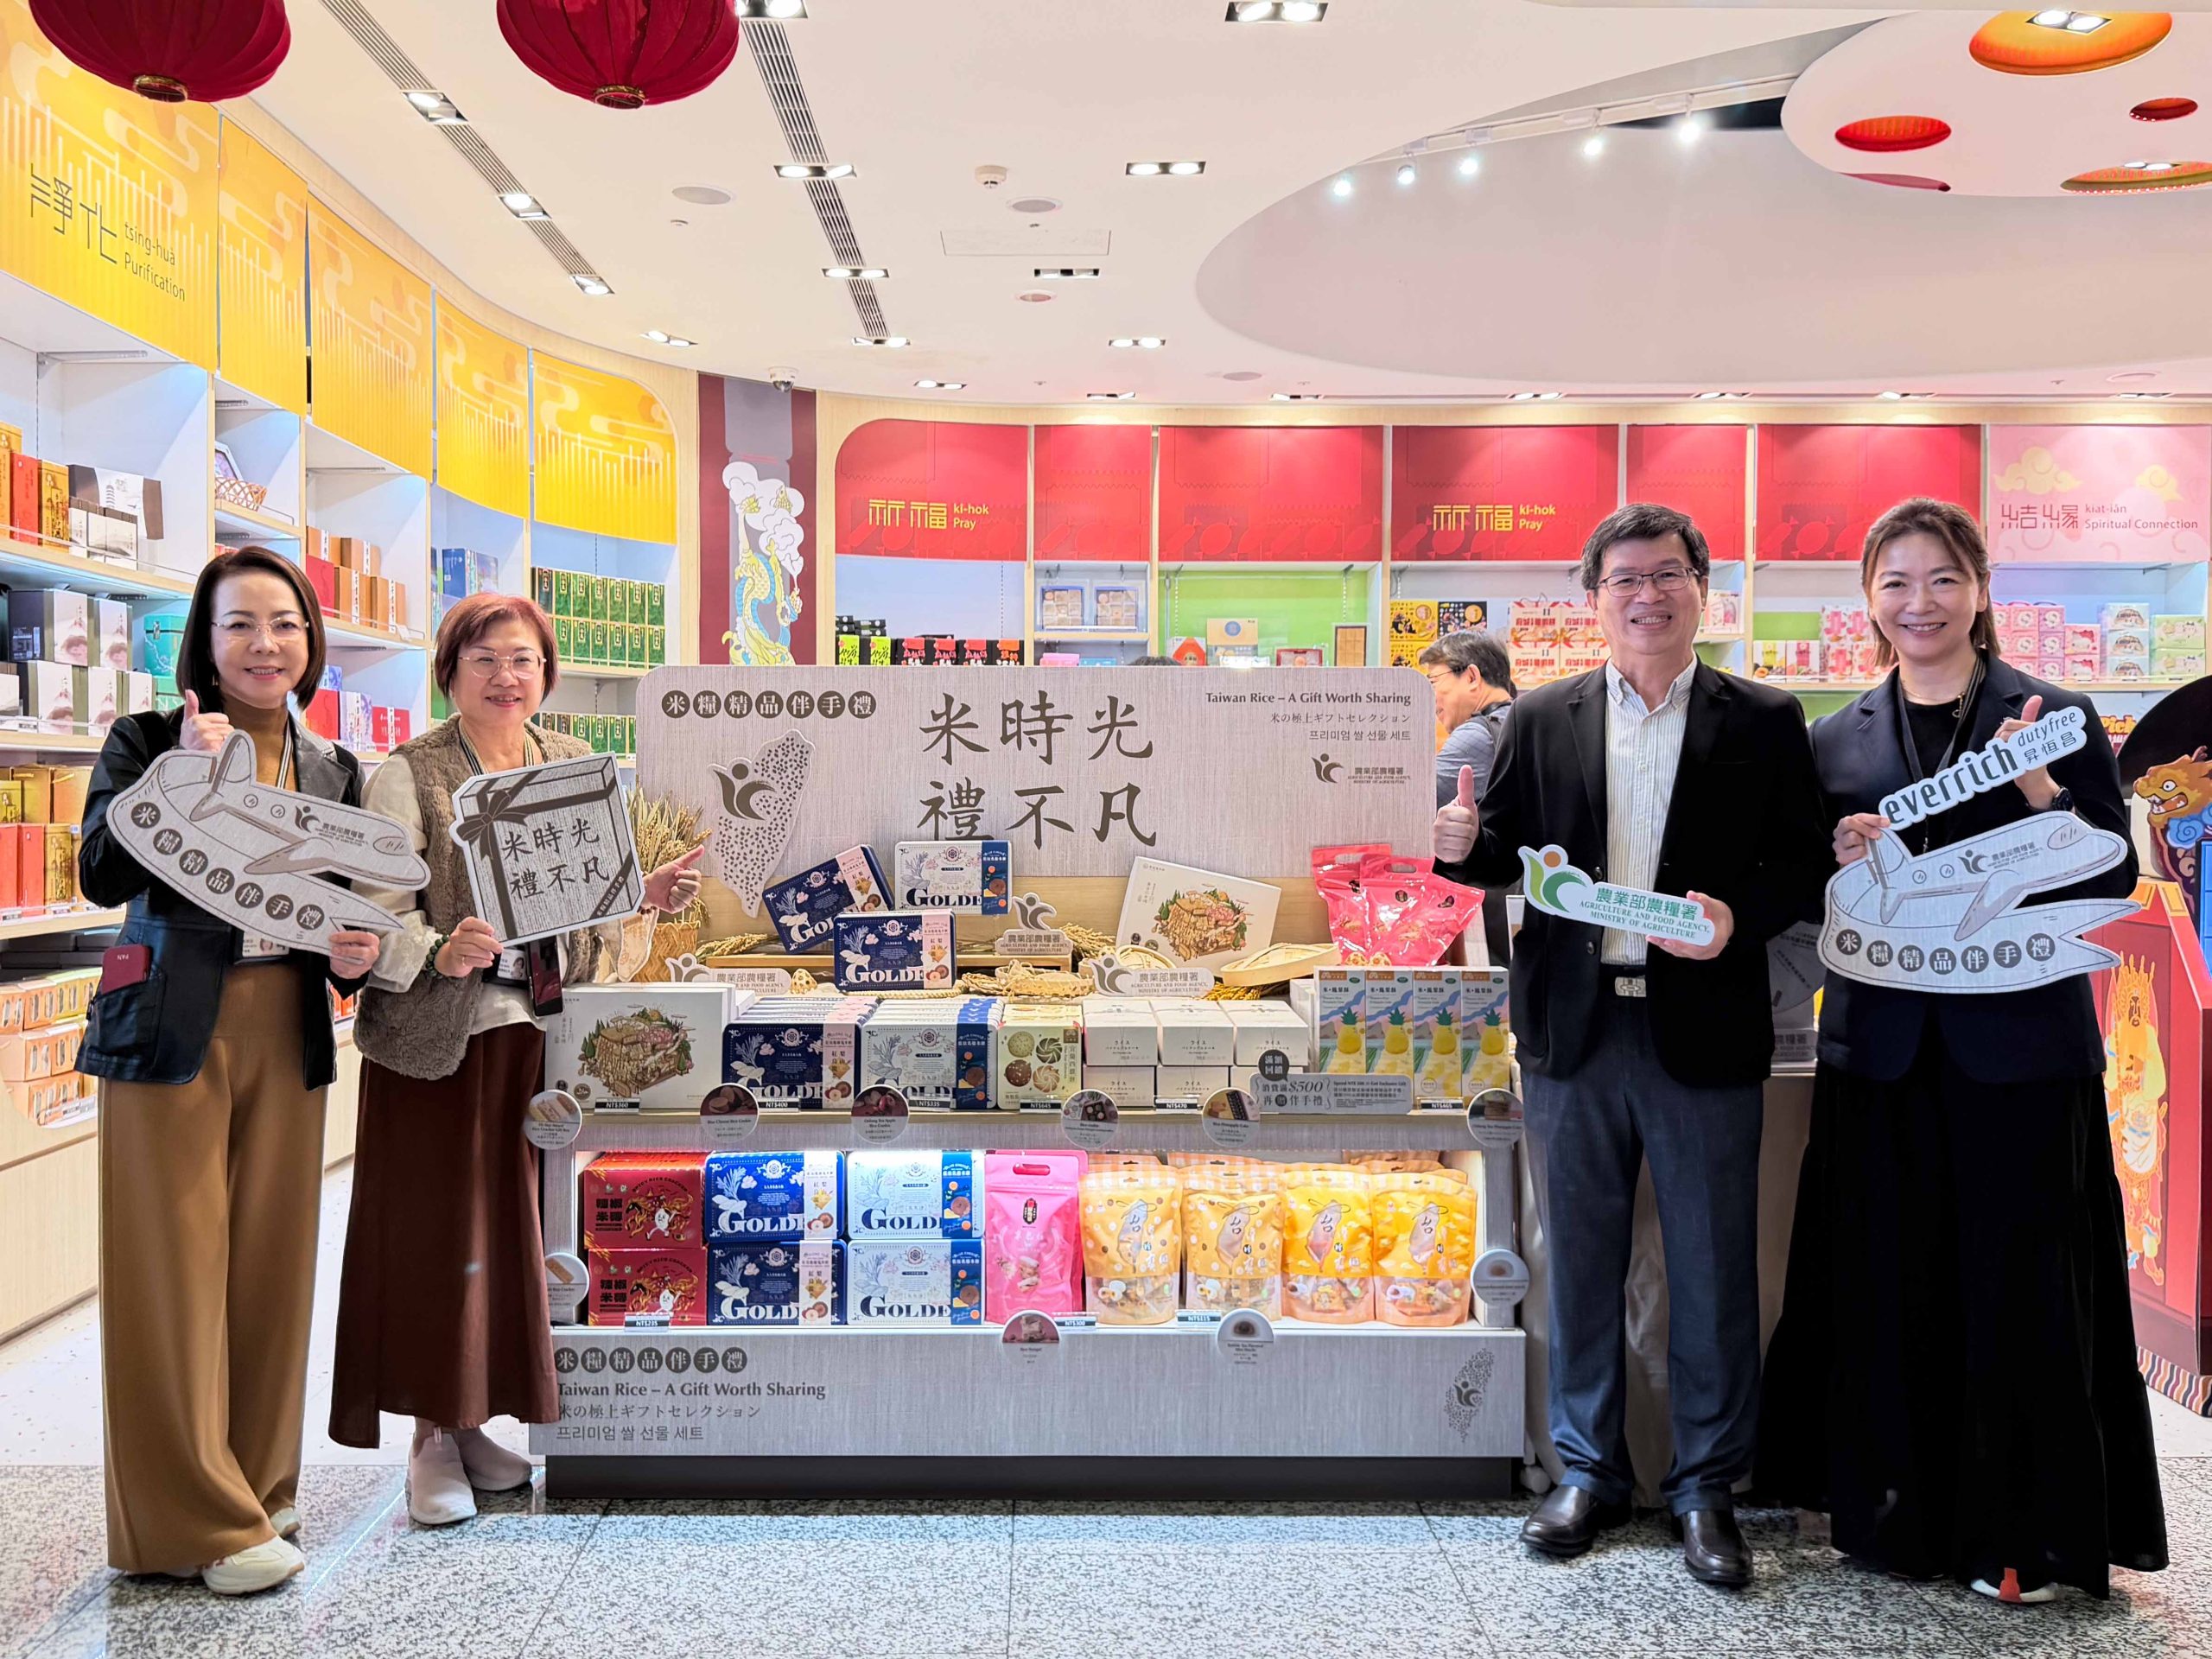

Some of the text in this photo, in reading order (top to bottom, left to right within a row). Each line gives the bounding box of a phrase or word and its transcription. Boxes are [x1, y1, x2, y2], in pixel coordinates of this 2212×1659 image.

[124, 251, 186, 302] Purification
[869, 499, 947, 530] 祈福
[953, 518, 976, 531] Pray
[1433, 505, 1513, 531] 祈福
[1519, 518, 1543, 531] Pray
[2085, 518, 2198, 531] Spiritual Connection
[663, 691, 875, 718] 米糧精品伴手禮
[1205, 692, 1246, 703] Taiwan
[1250, 692, 1274, 703] Rice
[1287, 692, 1296, 703] A
[1300, 692, 1322, 703] Gift
[1326, 692, 1362, 703] Worth
[1366, 692, 1411, 706] Sharing
[919, 690, 1153, 766] 米時光
[1270, 712, 1410, 724] 米の極上ギフトセレクション
[1309, 730, 1411, 741] 프리미엄 쌀 선물 세트
[1885, 709, 2077, 825] everrich dutyfree
[918, 777, 1156, 850] 禮不凡
[502, 818, 601, 861] 米時光
[132, 803, 324, 930] 米糧精品伴手禮
[510, 856, 610, 900] 禮不凡
[1579, 900, 1710, 934] AGRICULTURE AND FOOD AGENCY,
[1595, 887, 1698, 921] 農業部農糧署
[1591, 911, 1696, 939] MINISTRY OF AGRICULTURE
[1836, 930, 2056, 976] 米糧精品伴手禮
[717, 972, 776, 982] 農業部農糧署
[1139, 972, 1198, 982] 農業部農糧署
[721, 1297, 799, 1320] GOLD
[556, 1348, 746, 1372] 米糧精品伴手禮
[559, 1382, 609, 1395] Taiwan
[615, 1382, 647, 1395] Rice
[664, 1382, 674, 1395] A
[680, 1382, 709, 1395] Gift
[714, 1382, 761, 1395] Worth
[767, 1382, 826, 1400] Sharing
[559, 1404, 760, 1419] 米の極上ギフトセレクション
[556, 1425, 704, 1441] 프리미엄 쌀 선물 세트
